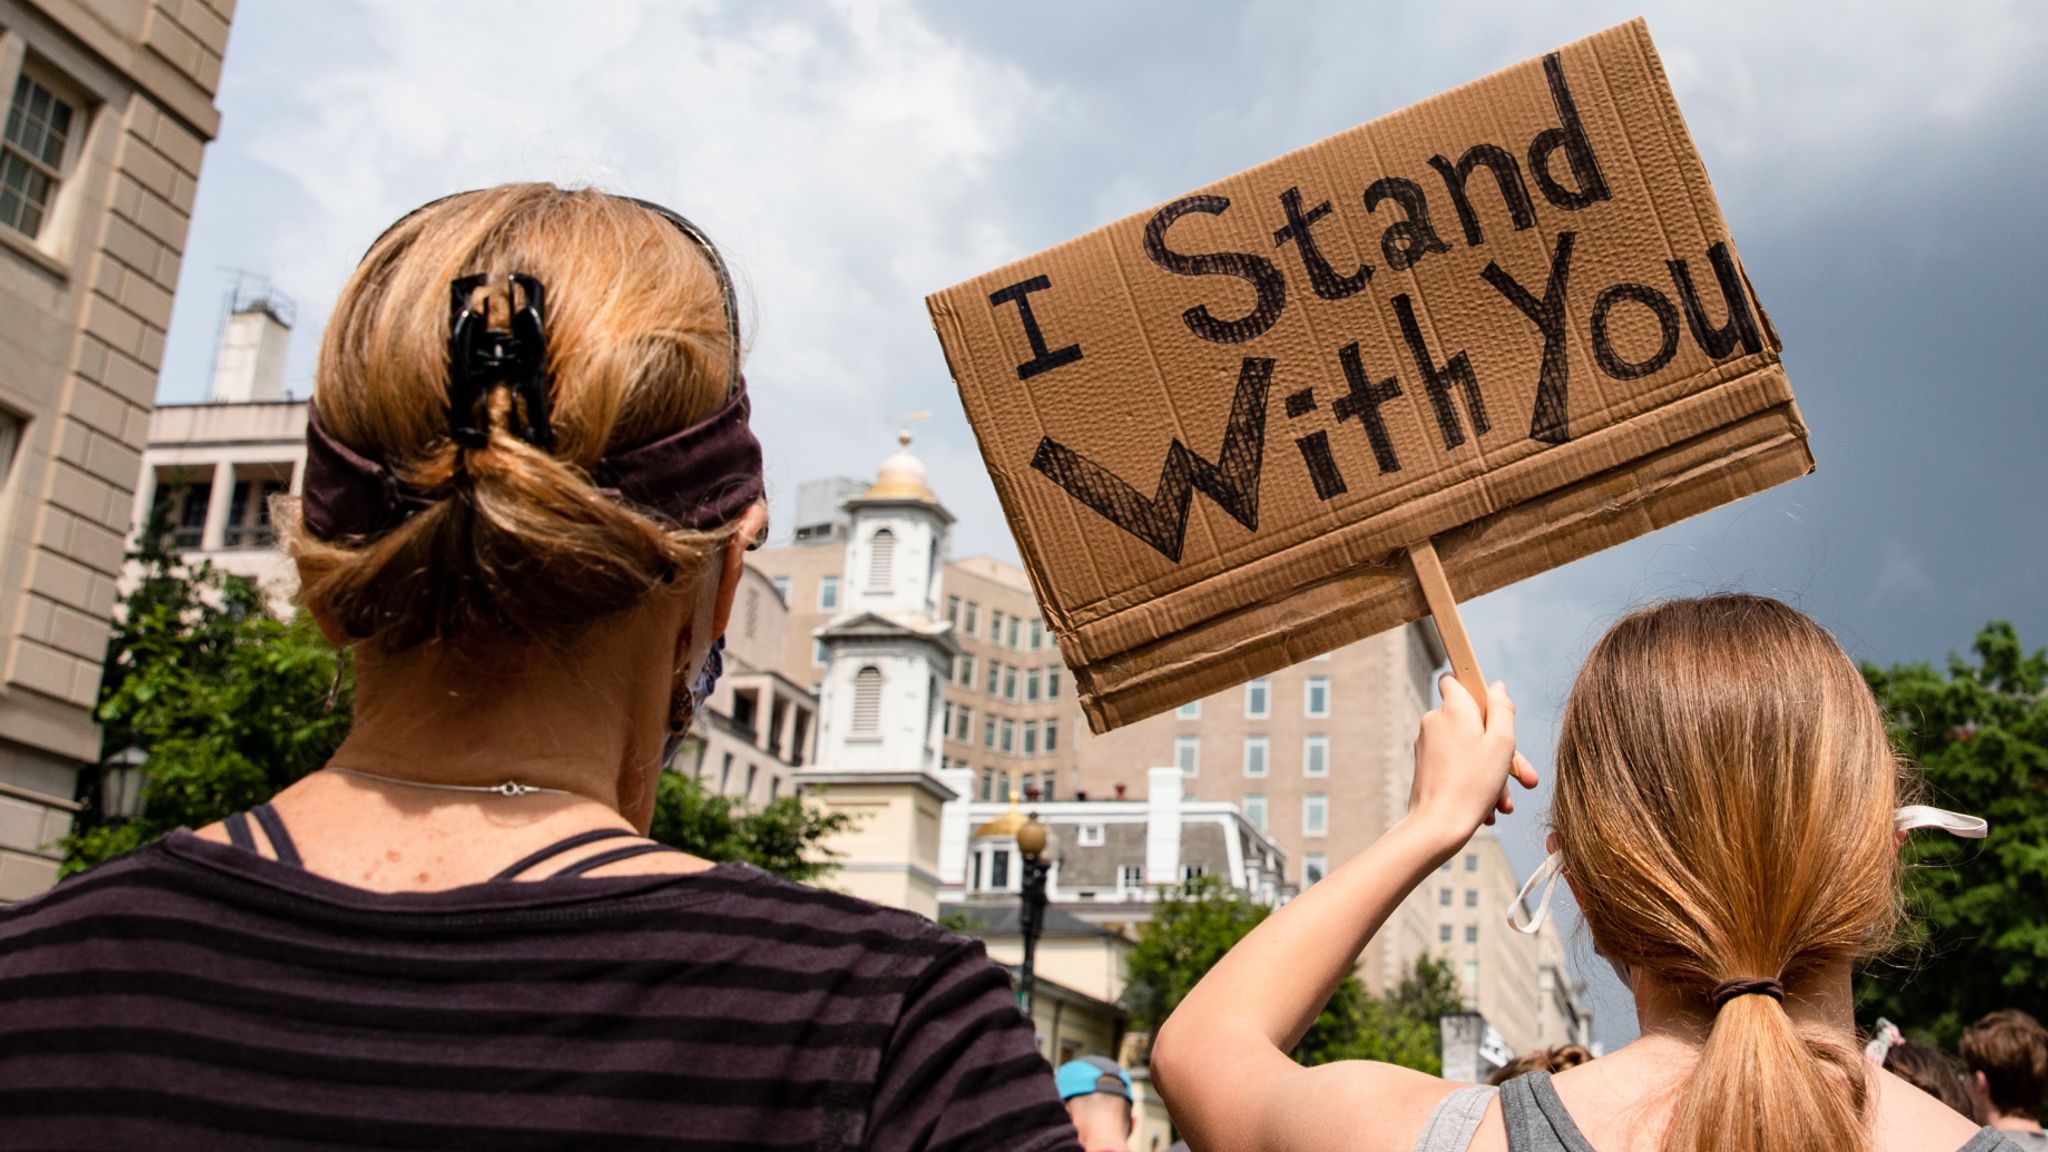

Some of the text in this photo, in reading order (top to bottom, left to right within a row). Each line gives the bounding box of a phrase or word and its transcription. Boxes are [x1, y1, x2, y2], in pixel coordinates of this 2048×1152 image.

[989, 52, 1612, 380] I Stand
[1030, 231, 1763, 563] With You
